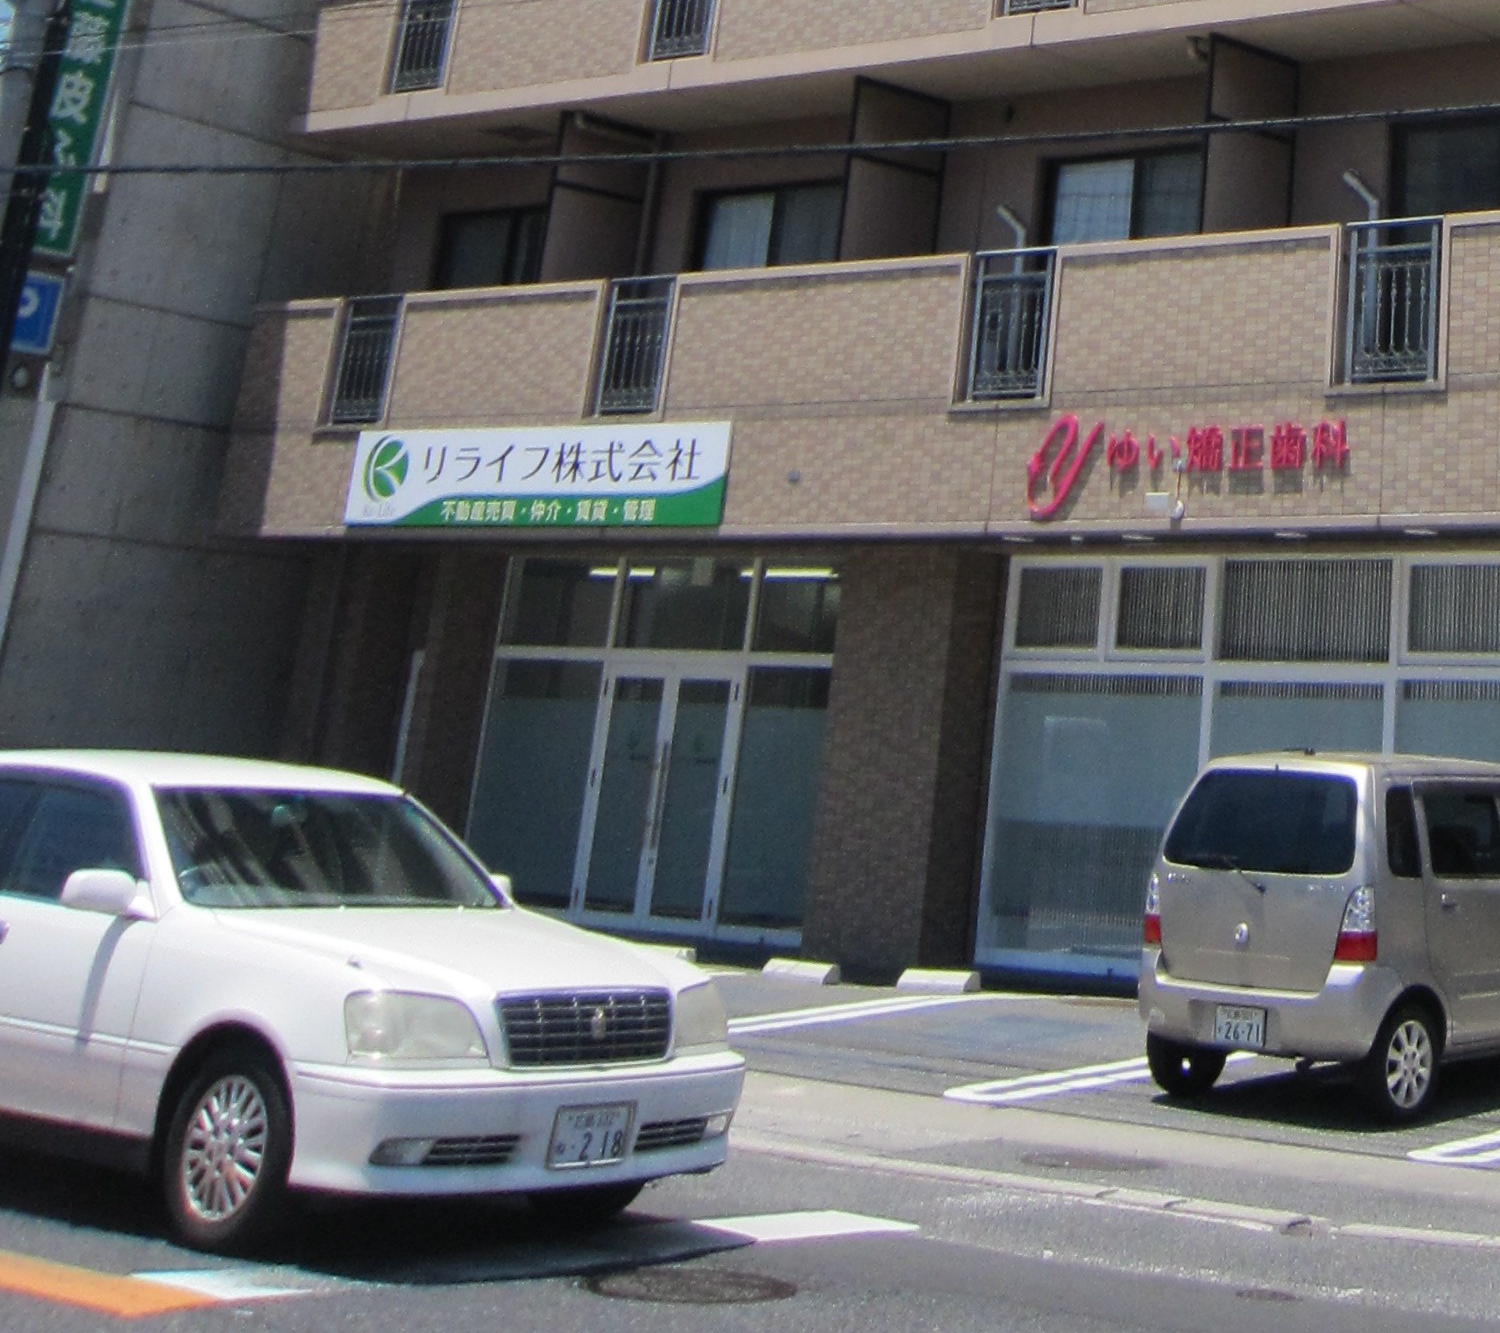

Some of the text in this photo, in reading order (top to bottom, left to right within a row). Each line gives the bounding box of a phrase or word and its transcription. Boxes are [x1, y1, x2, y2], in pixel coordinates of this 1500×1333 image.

[424, 438, 702, 483] リライフ株式会社
[1106, 420, 1349, 471] ゆい矯正歯科
